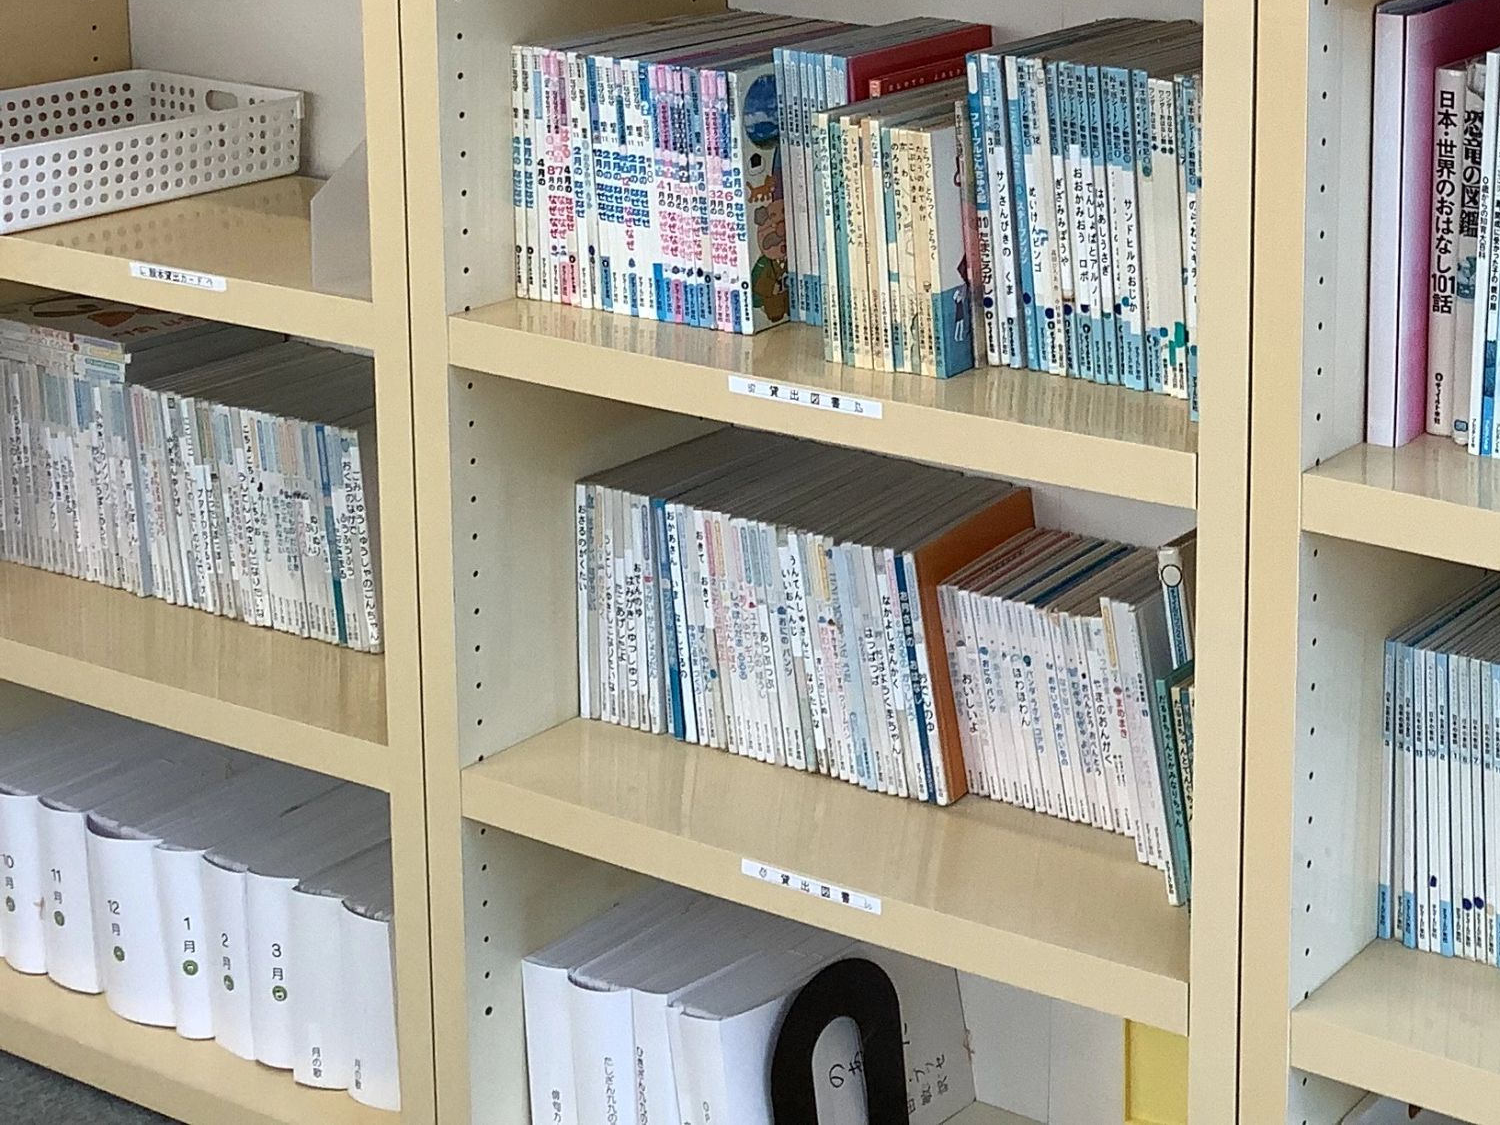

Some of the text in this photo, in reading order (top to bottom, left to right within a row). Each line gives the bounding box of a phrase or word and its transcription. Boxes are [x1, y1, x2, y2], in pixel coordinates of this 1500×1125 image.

[537, 158, 546, 186] 4月の
[547, 165, 555, 192] 8月の
[733, 167, 743, 198] 9月の
[890, 142, 903, 232] のろまなローラー
[1458, 110, 1484, 238] 恐竜の図鑑
[725, 190, 734, 219] 6月の
[922, 146, 937, 261] とらっく とらっく とらっく
[1055, 178, 1069, 267] ぎざみみぼうや
[1073, 168, 1089, 282] おおかみおう ロボ
[1096, 188, 1110, 277] はやあしうさぎ
[1431, 90, 1457, 315] 日本・世界のおはなし101話
[1004, 271, 1014, 296] くま
[1123, 199, 1138, 313] サンドヒルのおじか
[667, 512, 678, 567] おかあさん
[633, 563, 644, 618] おでんのゆ
[696, 531, 710, 609] おきて おきて
[782, 569, 798, 638] いいおへんじ
[882, 596, 900, 690] なかよしさんかく
[962, 674, 979, 734] おいしいよ
[986, 689, 997, 713] パンツ
[1157, 694, 1184, 829] だるまちゃんとかみなりちゃん
[2, 853, 15, 890] 10月
[50, 868, 63, 904] 11月
[107, 899, 122, 937] 12月
[183, 916, 196, 954] 1月
[221, 933, 233, 971] 2月
[270, 942, 284, 982] 3月
[603, 1057, 618, 1125] たしざん九九の
[635, 1046, 649, 1125] ひきざん九九の
